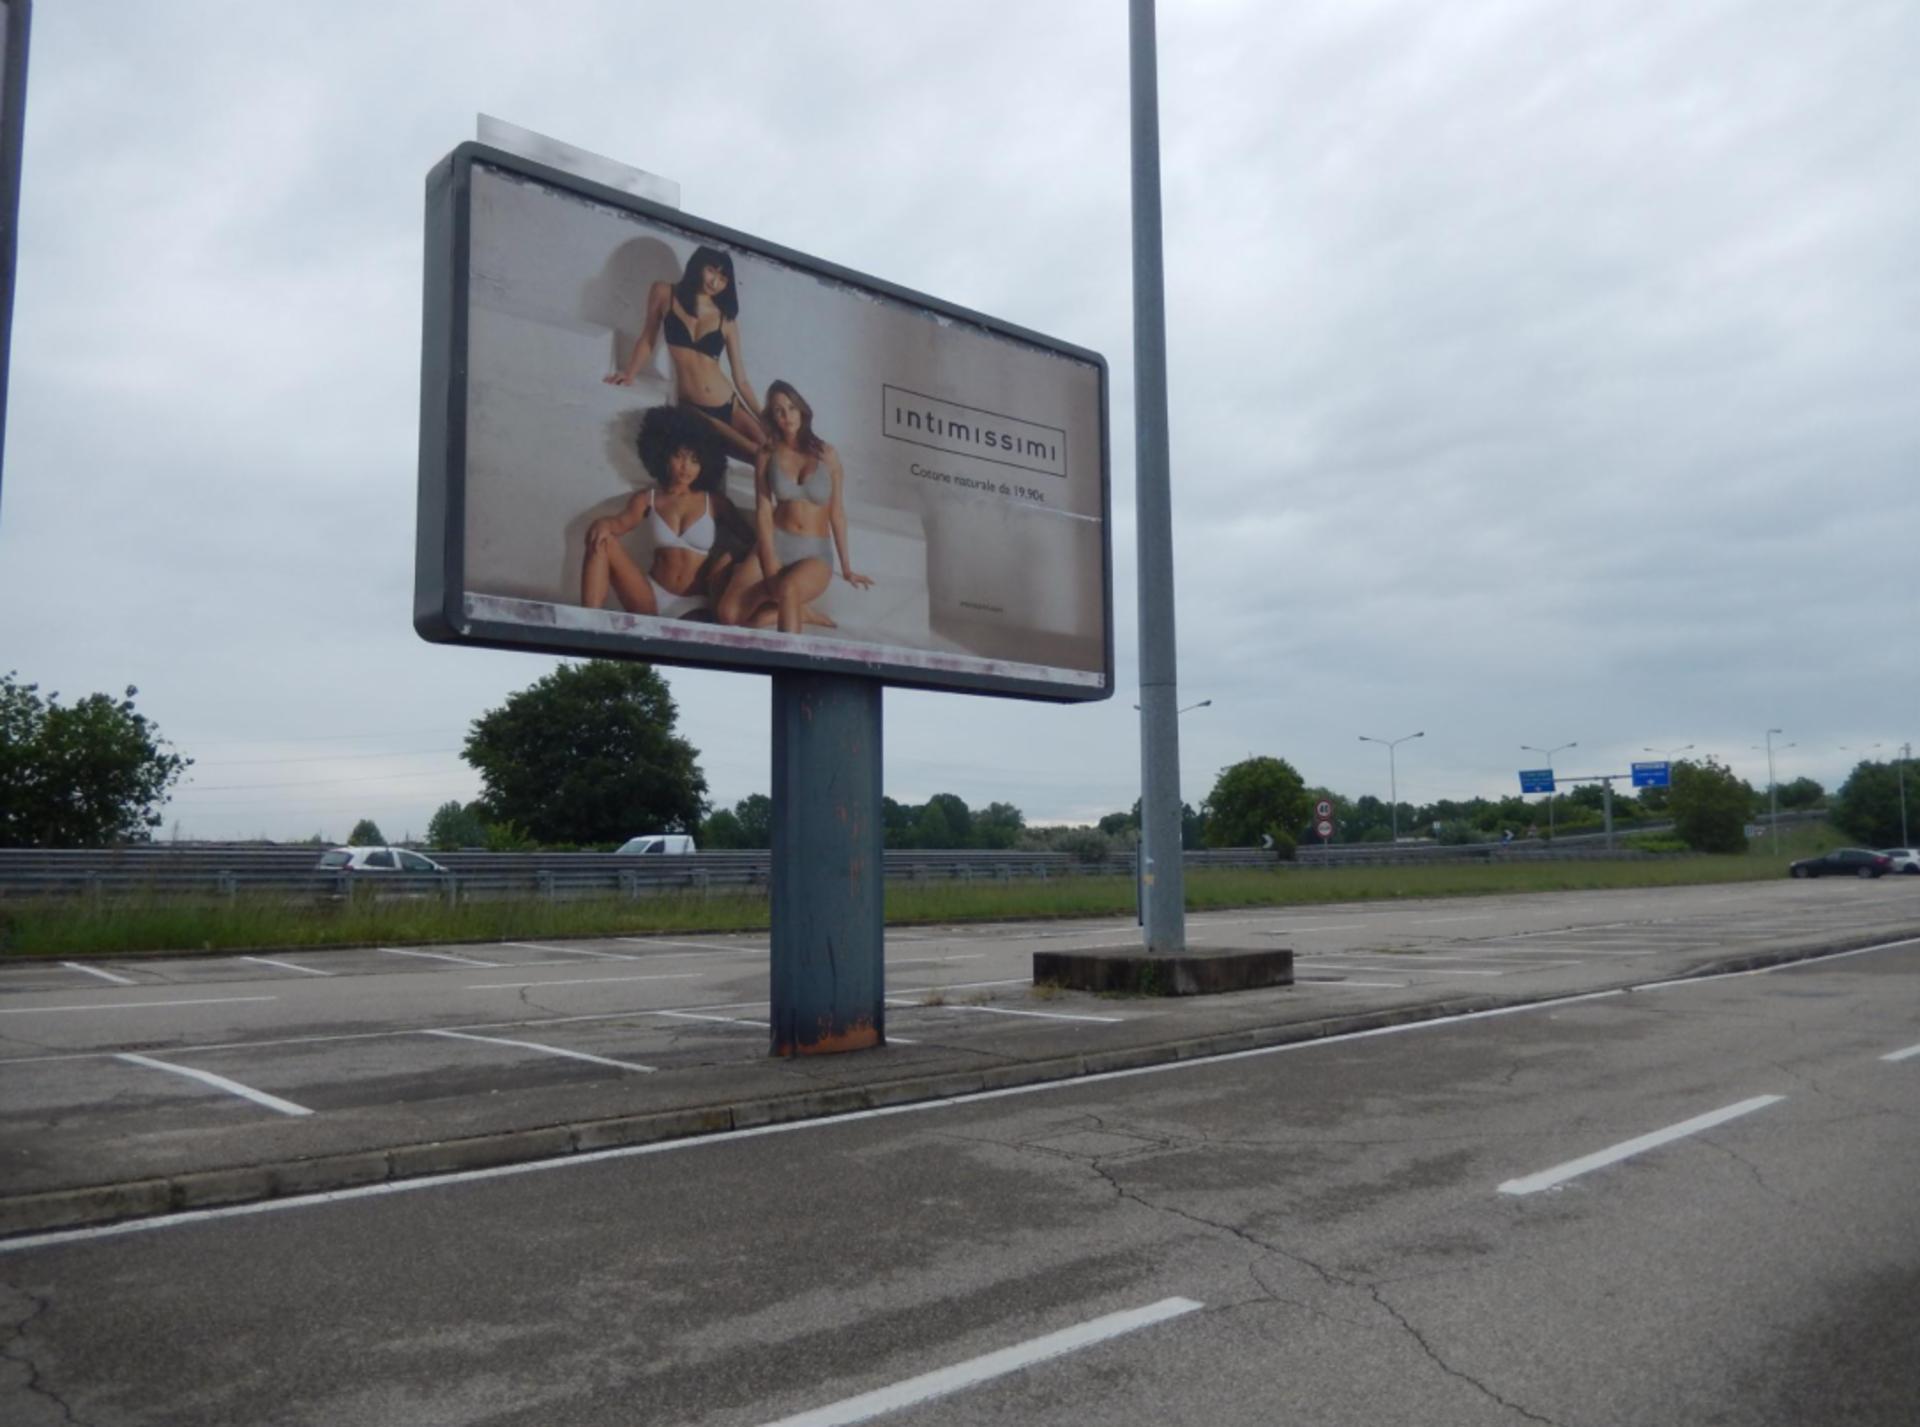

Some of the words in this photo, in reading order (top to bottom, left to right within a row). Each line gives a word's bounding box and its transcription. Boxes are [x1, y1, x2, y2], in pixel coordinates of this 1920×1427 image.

[896, 407, 1056, 461] intimissimi
[954, 476, 996, 492] naturale
[999, 483, 1010, 495] da
